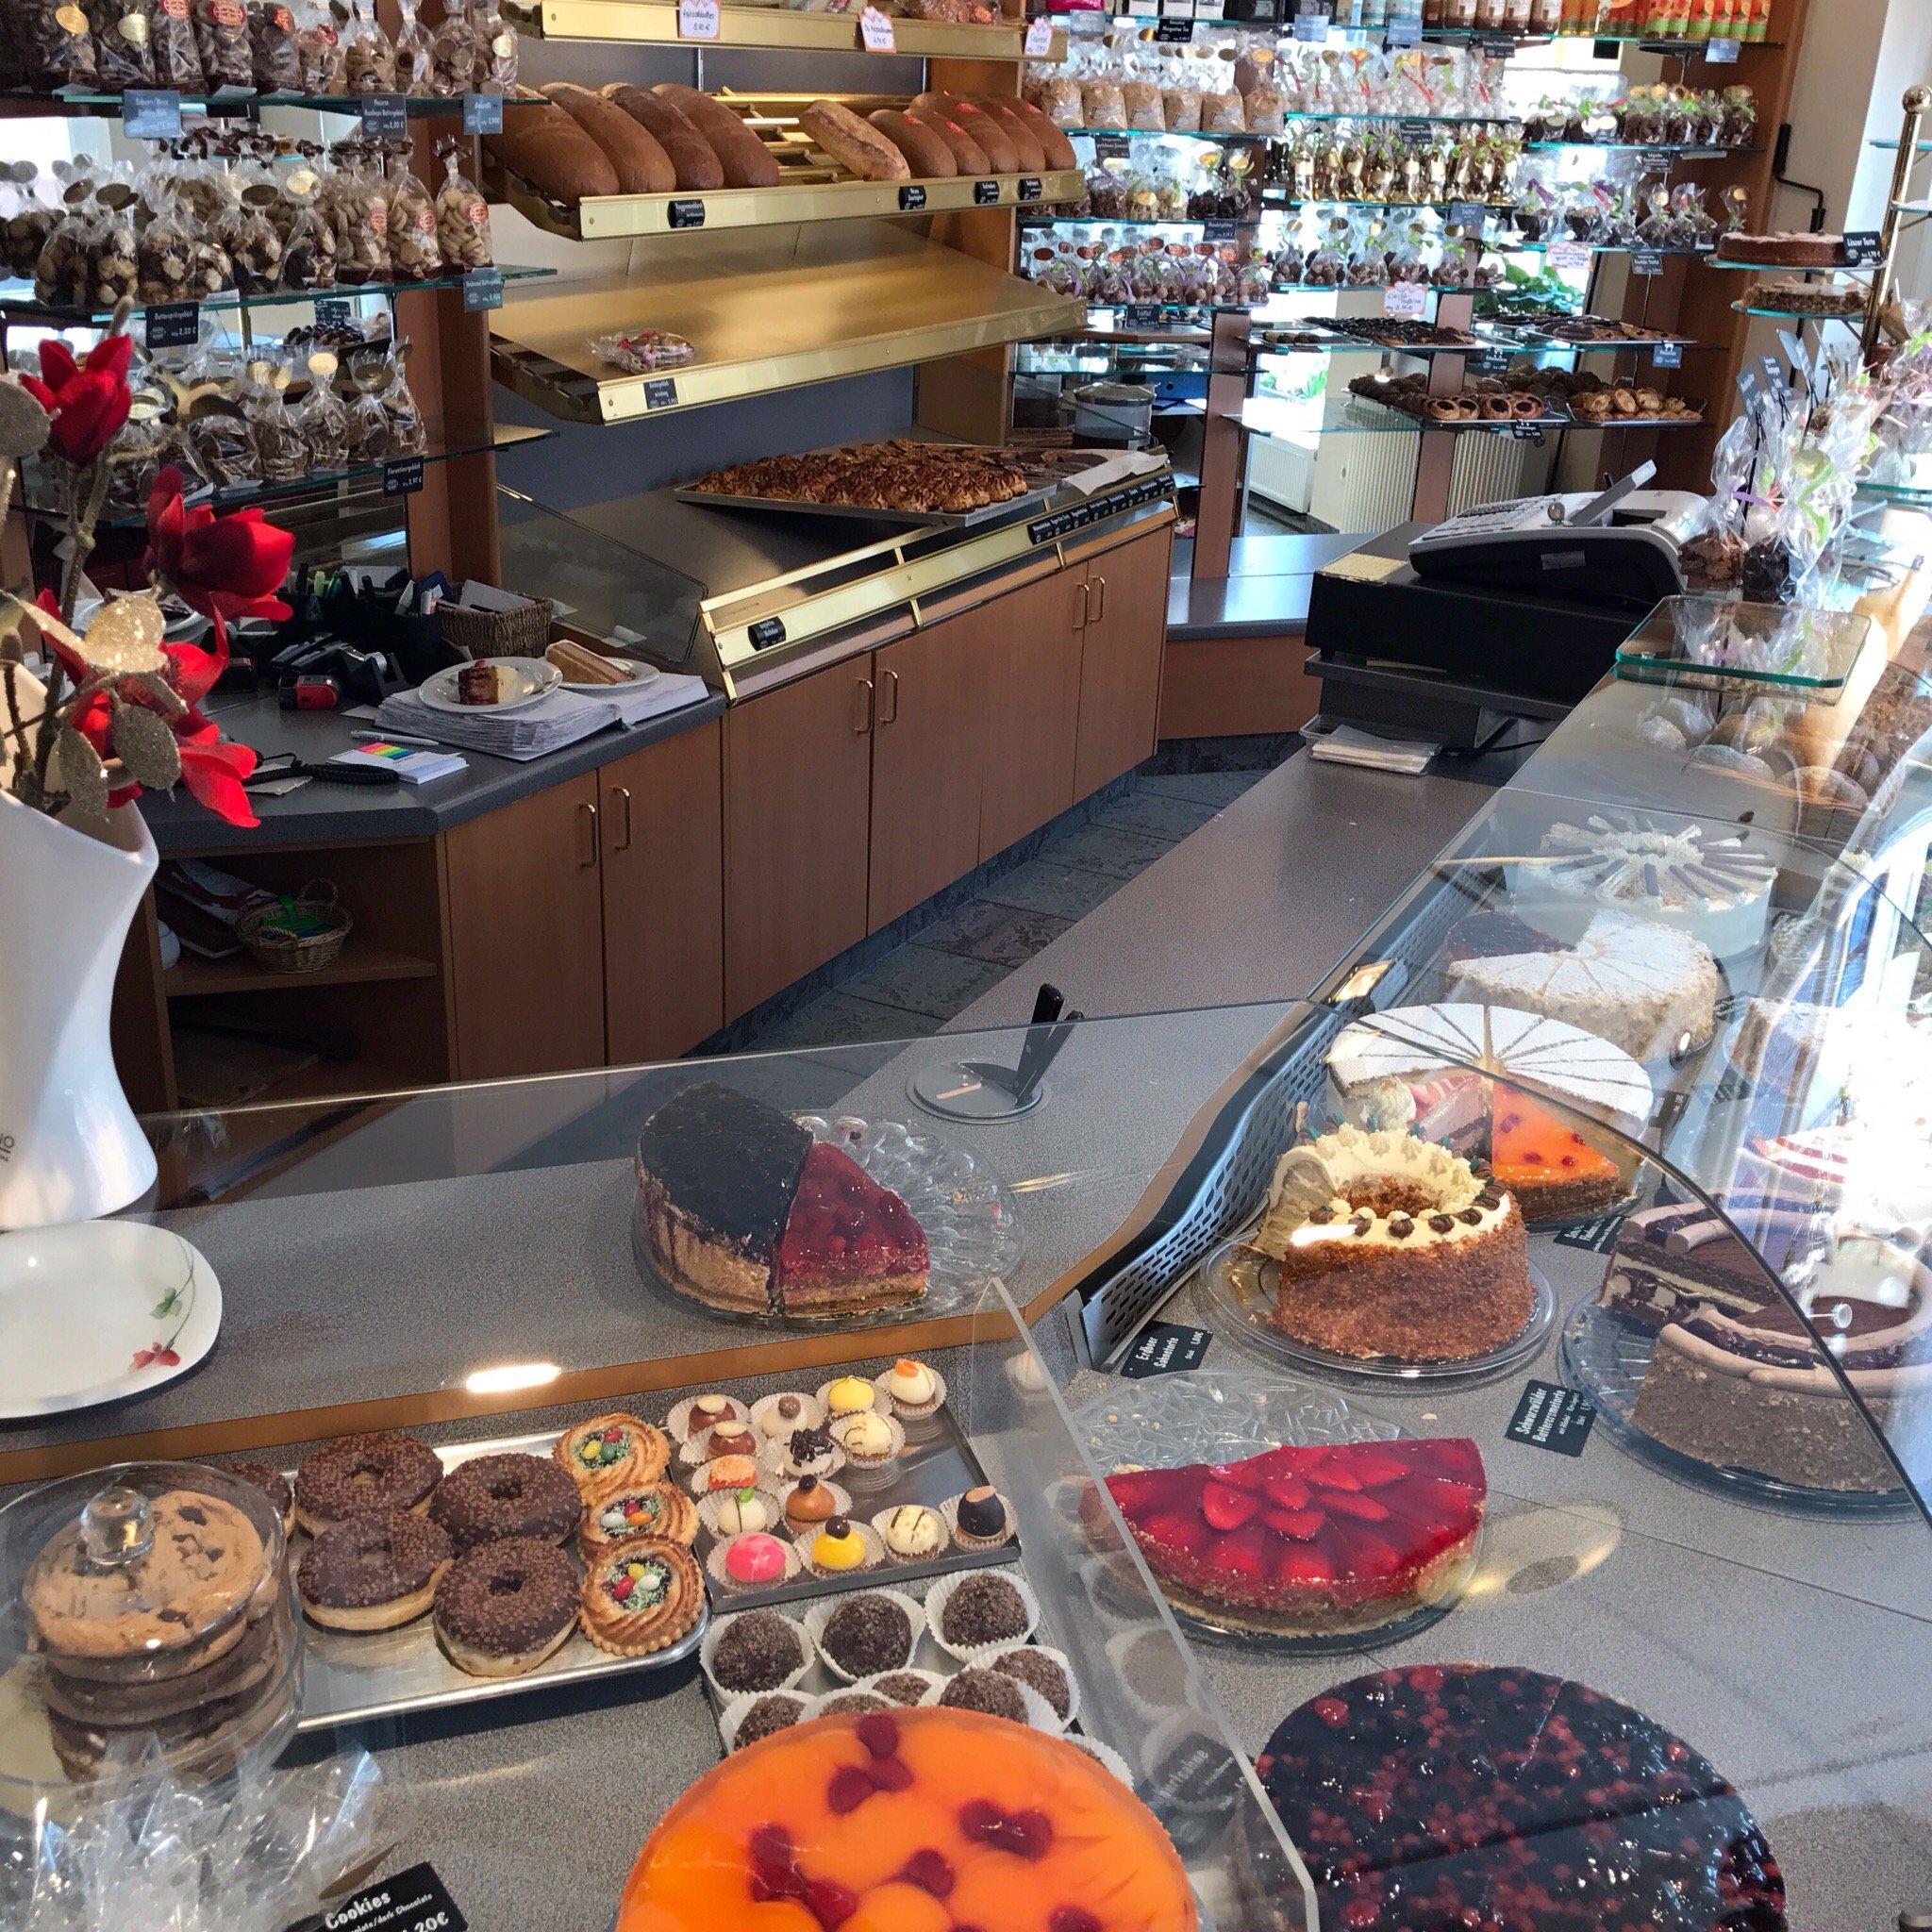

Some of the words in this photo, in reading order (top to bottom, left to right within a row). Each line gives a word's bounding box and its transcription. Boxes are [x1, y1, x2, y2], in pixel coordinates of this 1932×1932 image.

[1862, 237, 1876, 246] Torte
[1135, 1336, 1158, 1361] Erdbeer
[1153, 1337, 1179, 1369] Sahnetorte
[1514, 1387, 1548, 1435] Schwarzwälder
[1531, 1389, 1566, 1442] Buttercremetorte
[325, 1892, 391, 1930] Cookies
[395, 1893, 433, 1916] Chocolate
